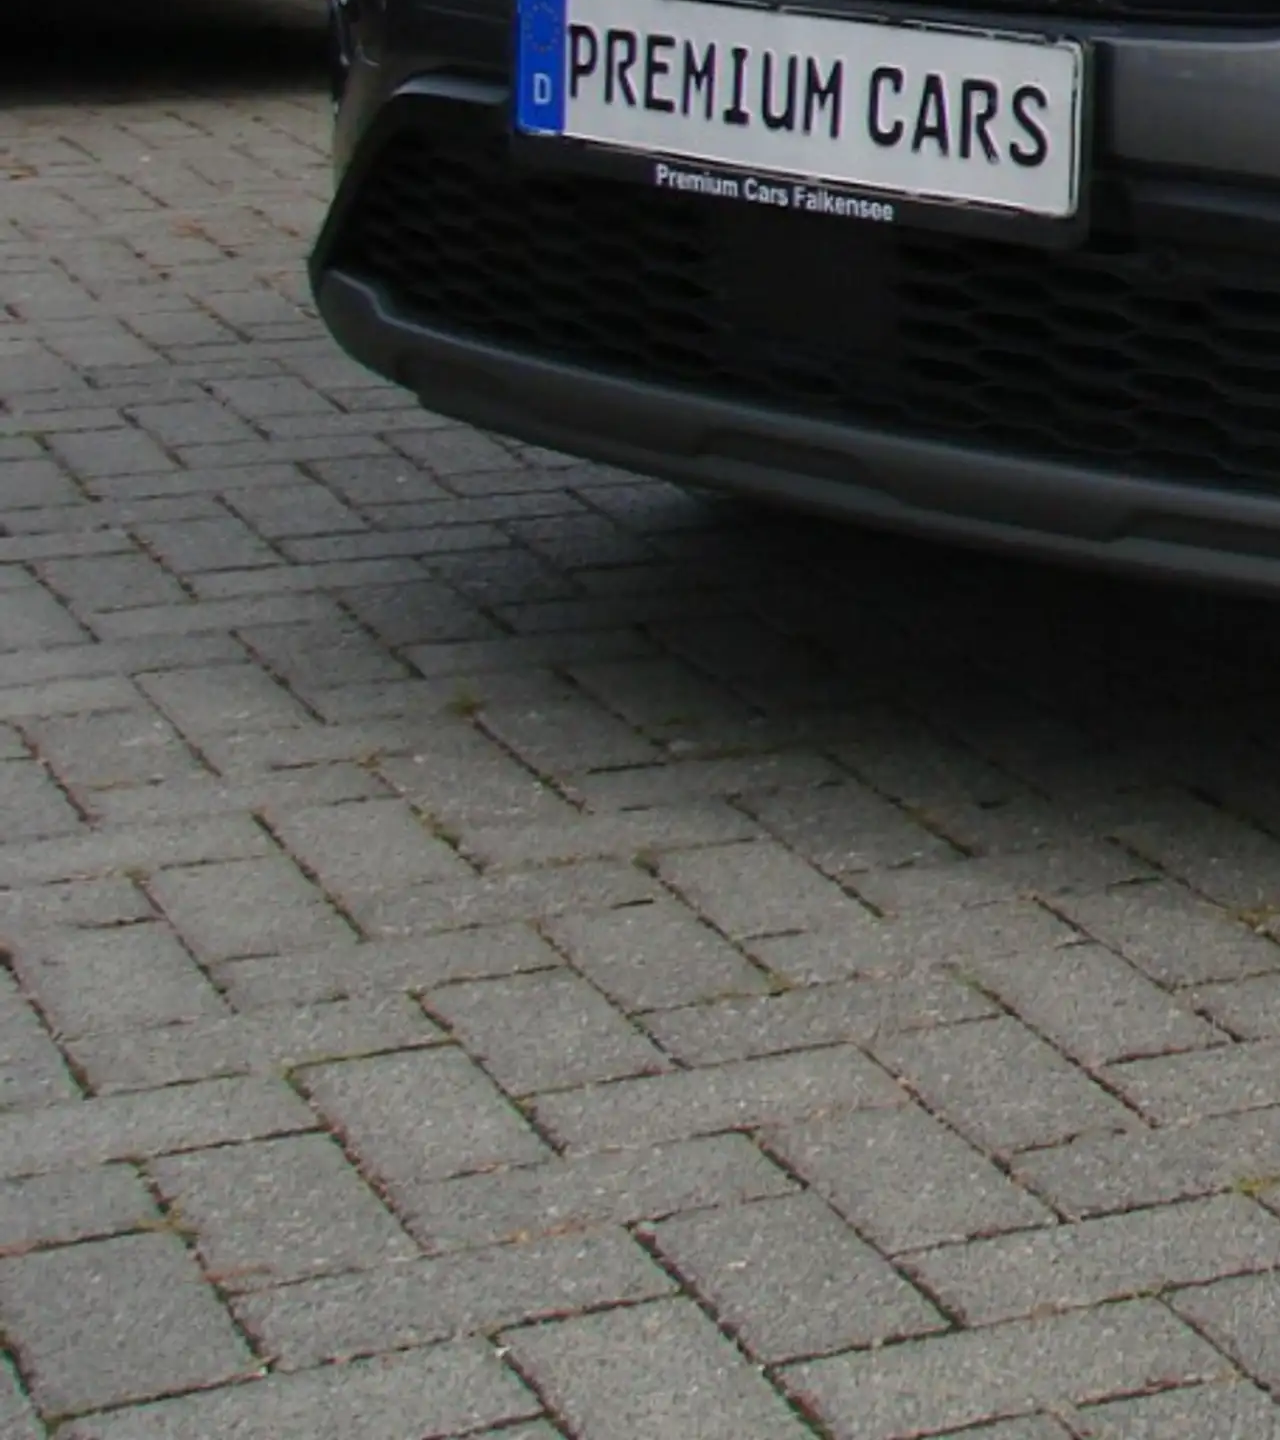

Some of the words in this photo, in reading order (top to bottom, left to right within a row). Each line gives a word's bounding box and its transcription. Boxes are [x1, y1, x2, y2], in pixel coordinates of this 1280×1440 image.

[533, 73, 550, 105] D
[568, 24, 844, 139] PREMIUM
[867, 66, 1049, 167] CARS
[655, 163, 739, 198] Premium
[743, 177, 789, 207] Cars
[792, 185, 894, 222] Falkensee
